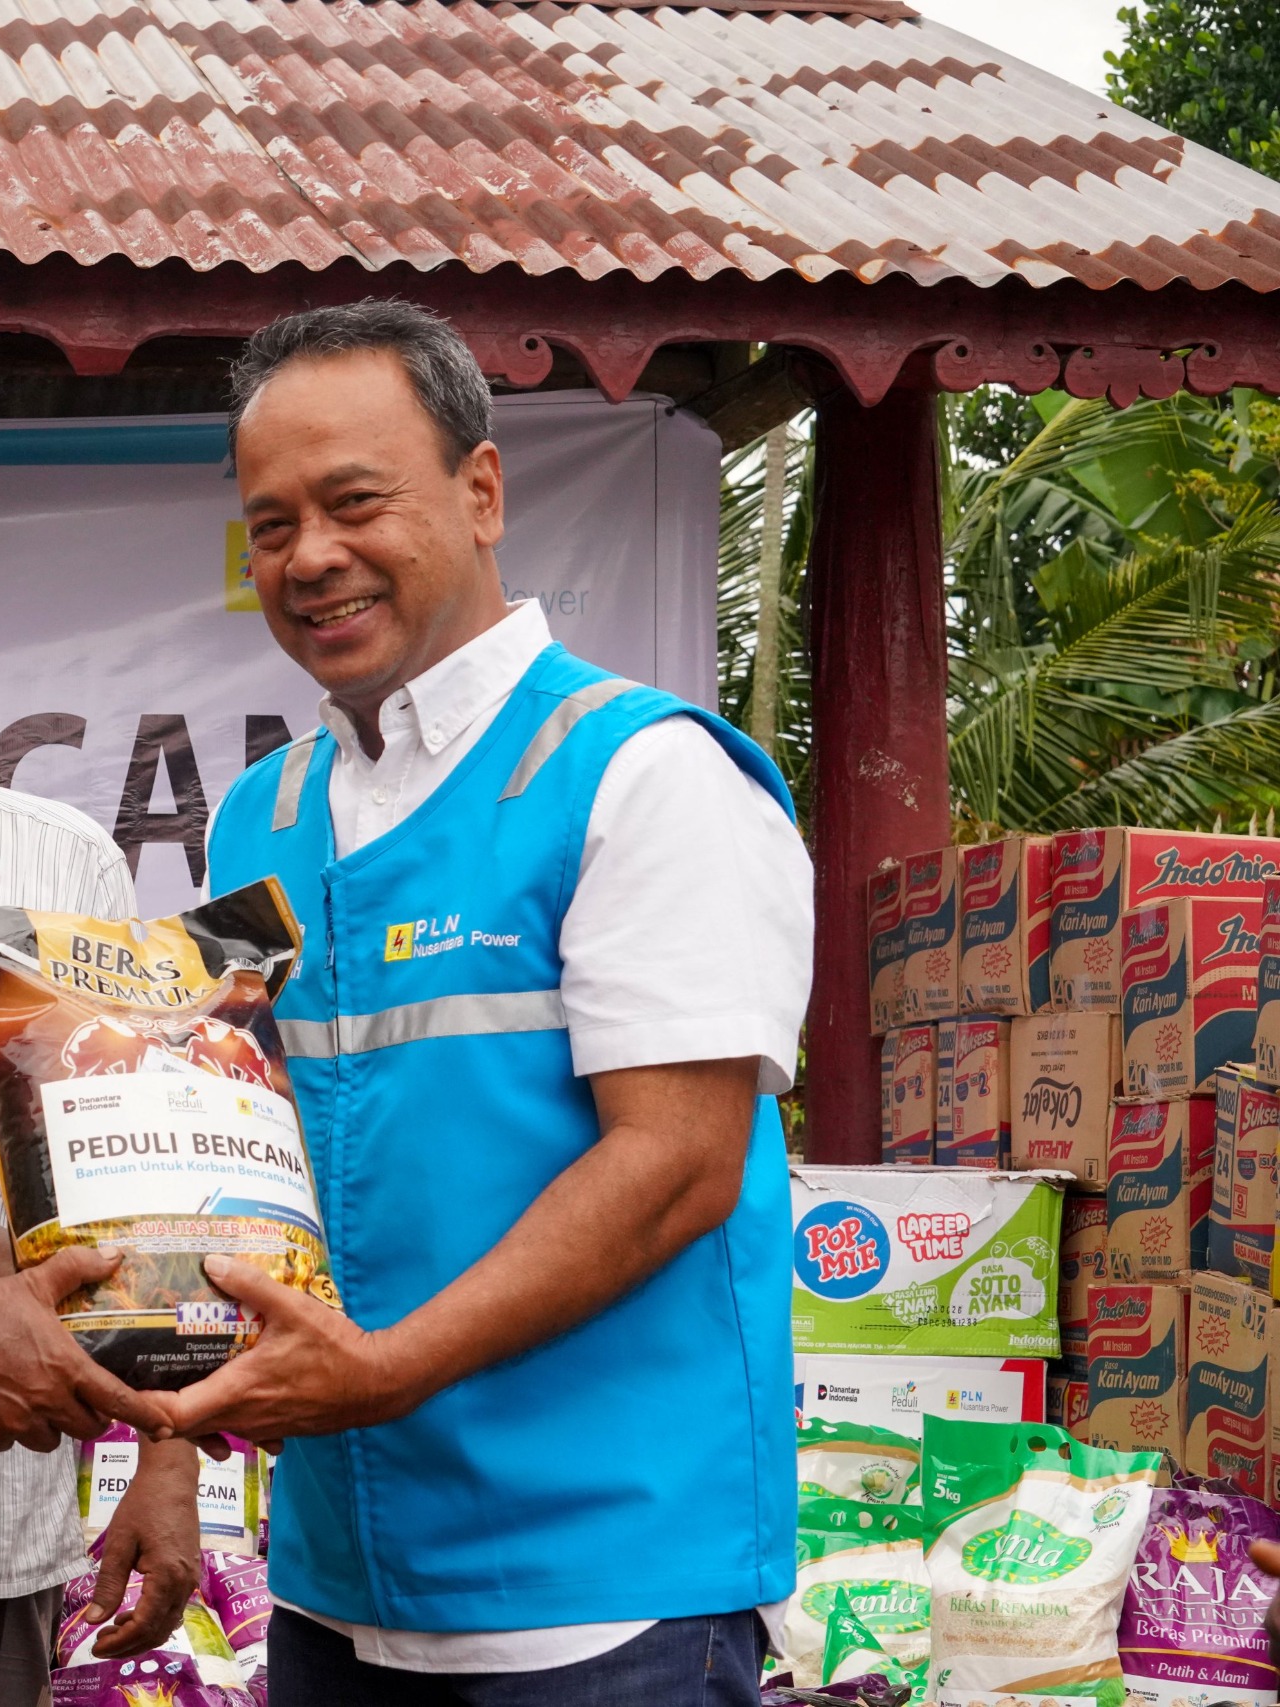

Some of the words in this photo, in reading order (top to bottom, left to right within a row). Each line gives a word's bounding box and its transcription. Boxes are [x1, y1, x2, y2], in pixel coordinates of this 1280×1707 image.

[414, 913, 461, 941] PLN
[966, 923, 982, 939] Kari
[982, 920, 1005, 940] Ayam
[1059, 912, 1080, 932] Kari
[1079, 912, 1108, 935] Ayam
[413, 935, 464, 958] Nusantara
[471, 930, 521, 947] Power
[72, 935, 181, 984] BERAS
[49, 960, 213, 1007] PREMIUM
[1132, 994, 1153, 1015] Kari
[1153, 992, 1178, 1016] Ayam
[78, 1094, 122, 1105] Danantara
[79, 1102, 120, 1112] Indonesia
[168, 1098, 203, 1110] Peduli
[252, 1101, 274, 1115] PLN
[1022, 1086, 1082, 1130] Cokelat
[68, 1132, 178, 1162] PEDULI
[192, 1133, 305, 1178] BENCANA
[1028, 1140, 1073, 1160] ALPELLA
[75, 1161, 137, 1180] Bantuan
[140, 1160, 184, 1172] Untuk
[187, 1160, 235, 1174] Korban
[238, 1164, 286, 1185] Bencana
[287, 1177, 309, 1194] Aceh
[1116, 1182, 1140, 1203] Kari
[1139, 1184, 1169, 1207] Ayam
[133, 1221, 209, 1236] KUALITAS
[212, 1222, 283, 1236] TERJAMIN
[806, 1217, 862, 1261] POP
[910, 1236, 963, 1262] TIME
[818, 1239, 881, 1282] MIE
[981, 1265, 1004, 1275] RASA
[894, 1290, 914, 1299] RASA
[915, 1287, 935, 1297] LEBIH
[969, 1275, 1021, 1295] SOTO
[176, 1302, 237, 1324] 100%
[896, 1296, 937, 1315] ENAK
[969, 1295, 1021, 1315] AYAM
[1090, 1296, 1146, 1327] Indomie
[176, 1322, 261, 1335] INDONESIA
[186, 1342, 228, 1352] Diproduksi
[1103, 1342, 1112, 1351] Mi
[1113, 1342, 1132, 1351] Instan
[150, 1353, 190, 1362] BINTANG
[192, 1353, 228, 1361] TERANG
[1104, 1361, 1118, 1370] Rasa
[829, 1385, 860, 1395] Danantara
[1098, 1370, 1122, 1390] Kari
[1122, 1371, 1160, 1395] Ayam
[1199, 1369, 1230, 1393] Ayam
[829, 1394, 858, 1402] Indonesia
[892, 1387, 906, 1396] PLN
[961, 1391, 983, 1402] PLN
[1230, 1383, 1254, 1405] Kari
[892, 1396, 918, 1408] Peduli
[961, 1402, 990, 1412] Nusantara
[991, 1404, 1009, 1413] Power
[933, 1478, 961, 1504] 5kg
[1130, 1562, 1272, 1603] RAJA
[950, 1597, 986, 1612] BERAS
[990, 1598, 1070, 1618] PREMIUM
[840, 1621, 866, 1643] 5kg
[1136, 1619, 1187, 1642] Beras
[1192, 1629, 1270, 1650] Premium
[77, 1676, 101, 1684] UMUM
[1157, 1662, 1194, 1680] Putih
[1198, 1668, 1209, 1680] &
[1211, 1668, 1250, 1685] Alami
[1132, 1688, 1159, 1698] Danantara
